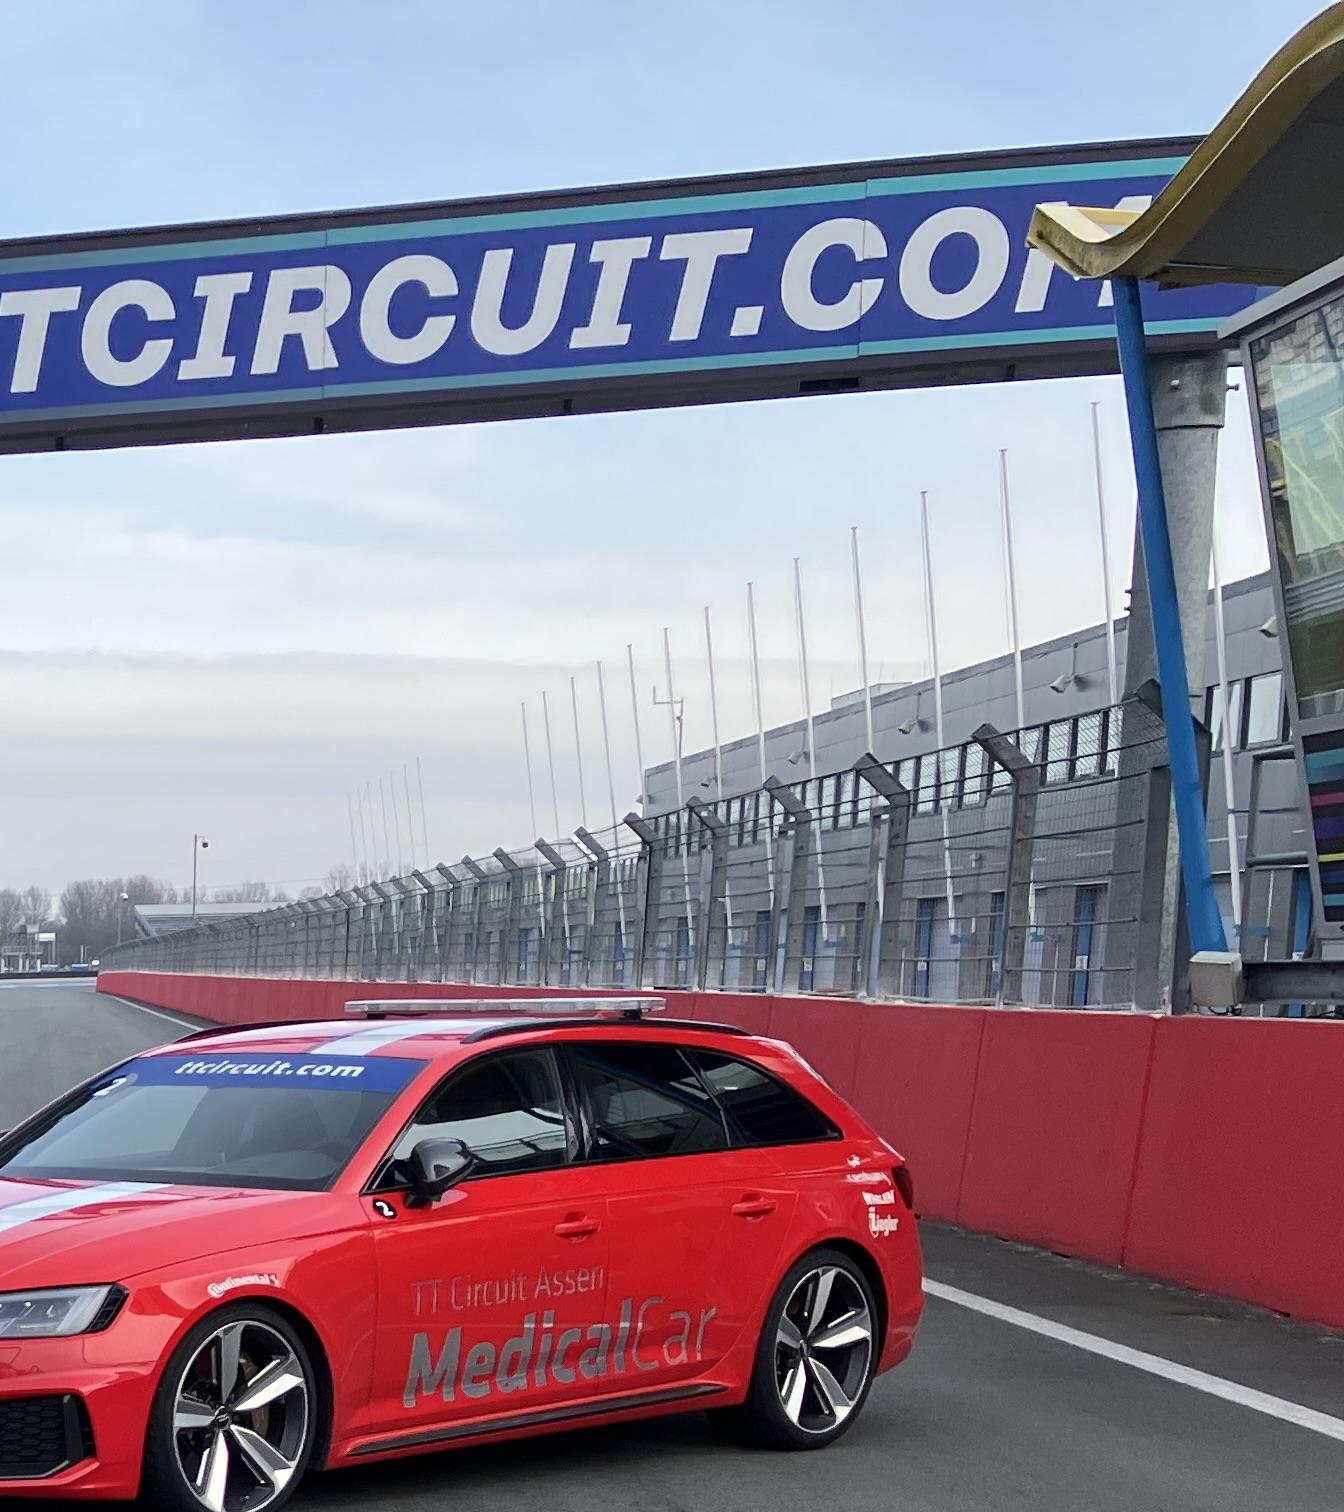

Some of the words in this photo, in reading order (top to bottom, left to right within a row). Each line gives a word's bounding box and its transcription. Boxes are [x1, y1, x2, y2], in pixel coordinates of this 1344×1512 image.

[174, 1060, 365, 1078] ttcircuit.com
[375, 1201, 394, 1217] 2
[412, 1279, 443, 1315] TT
[450, 1267, 528, 1311] Circuit
[534, 1264, 605, 1298] Assen
[403, 1296, 717, 1409] MedicalCar
